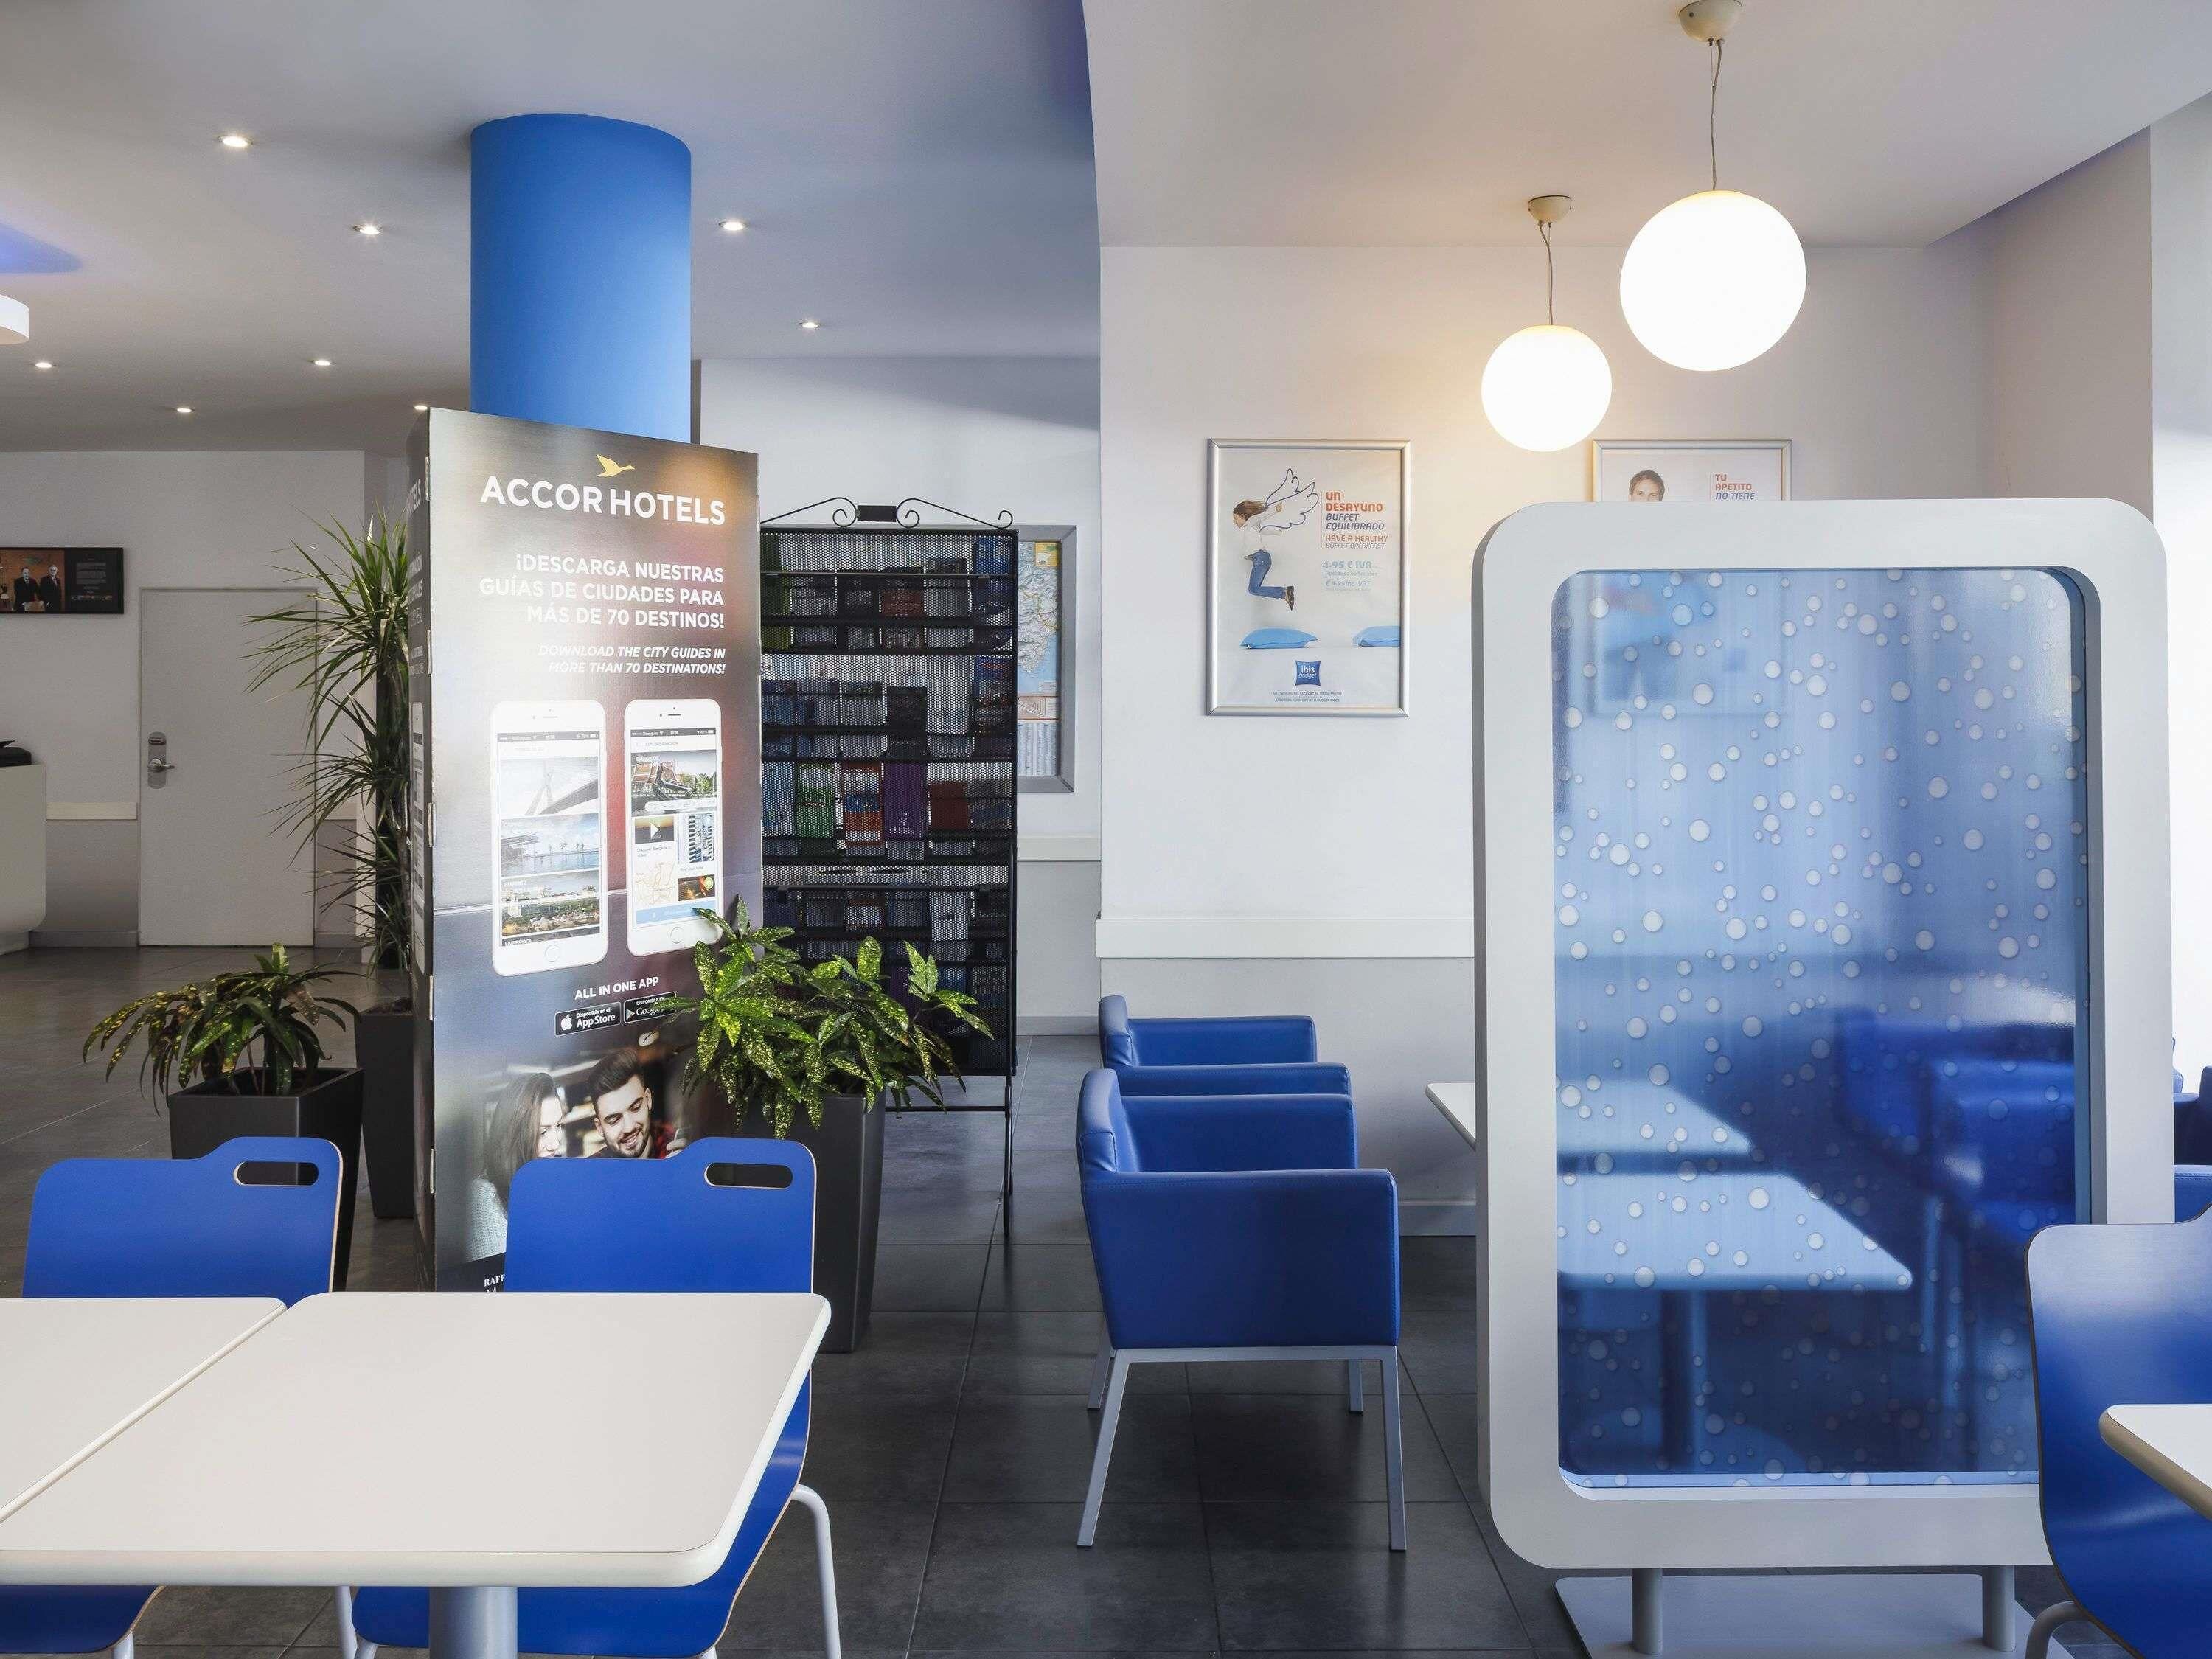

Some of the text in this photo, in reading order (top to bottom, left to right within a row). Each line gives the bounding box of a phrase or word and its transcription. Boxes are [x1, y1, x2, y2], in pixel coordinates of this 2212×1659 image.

[1715, 473, 1727, 481] TU
[1715, 483, 1752, 491] APETITO
[1326, 503, 1383, 512] DESAYUNO
[1326, 513, 1360, 521] BUFFET
[1326, 522, 1385, 532] EQUILIBRADO
[516, 554, 725, 583] ¡DESCARGA NUESTRAS
[479, 575, 725, 606] GUÍAS DE CIUDADES PARA
[526, 603, 725, 629] MÁS DE 70 DESTINOS!
[538, 645, 726, 658] DOWNLOAD THE CITY GUIDES IN
[548, 662, 726, 675] MORE THAN 70 DESTINATIONS!
[1301, 665, 1316, 674] ibis
[574, 977, 659, 1001] ALL IN ONE APP
[636, 1007, 659, 1016] Goog
[576, 1014, 616, 1029] App Store
